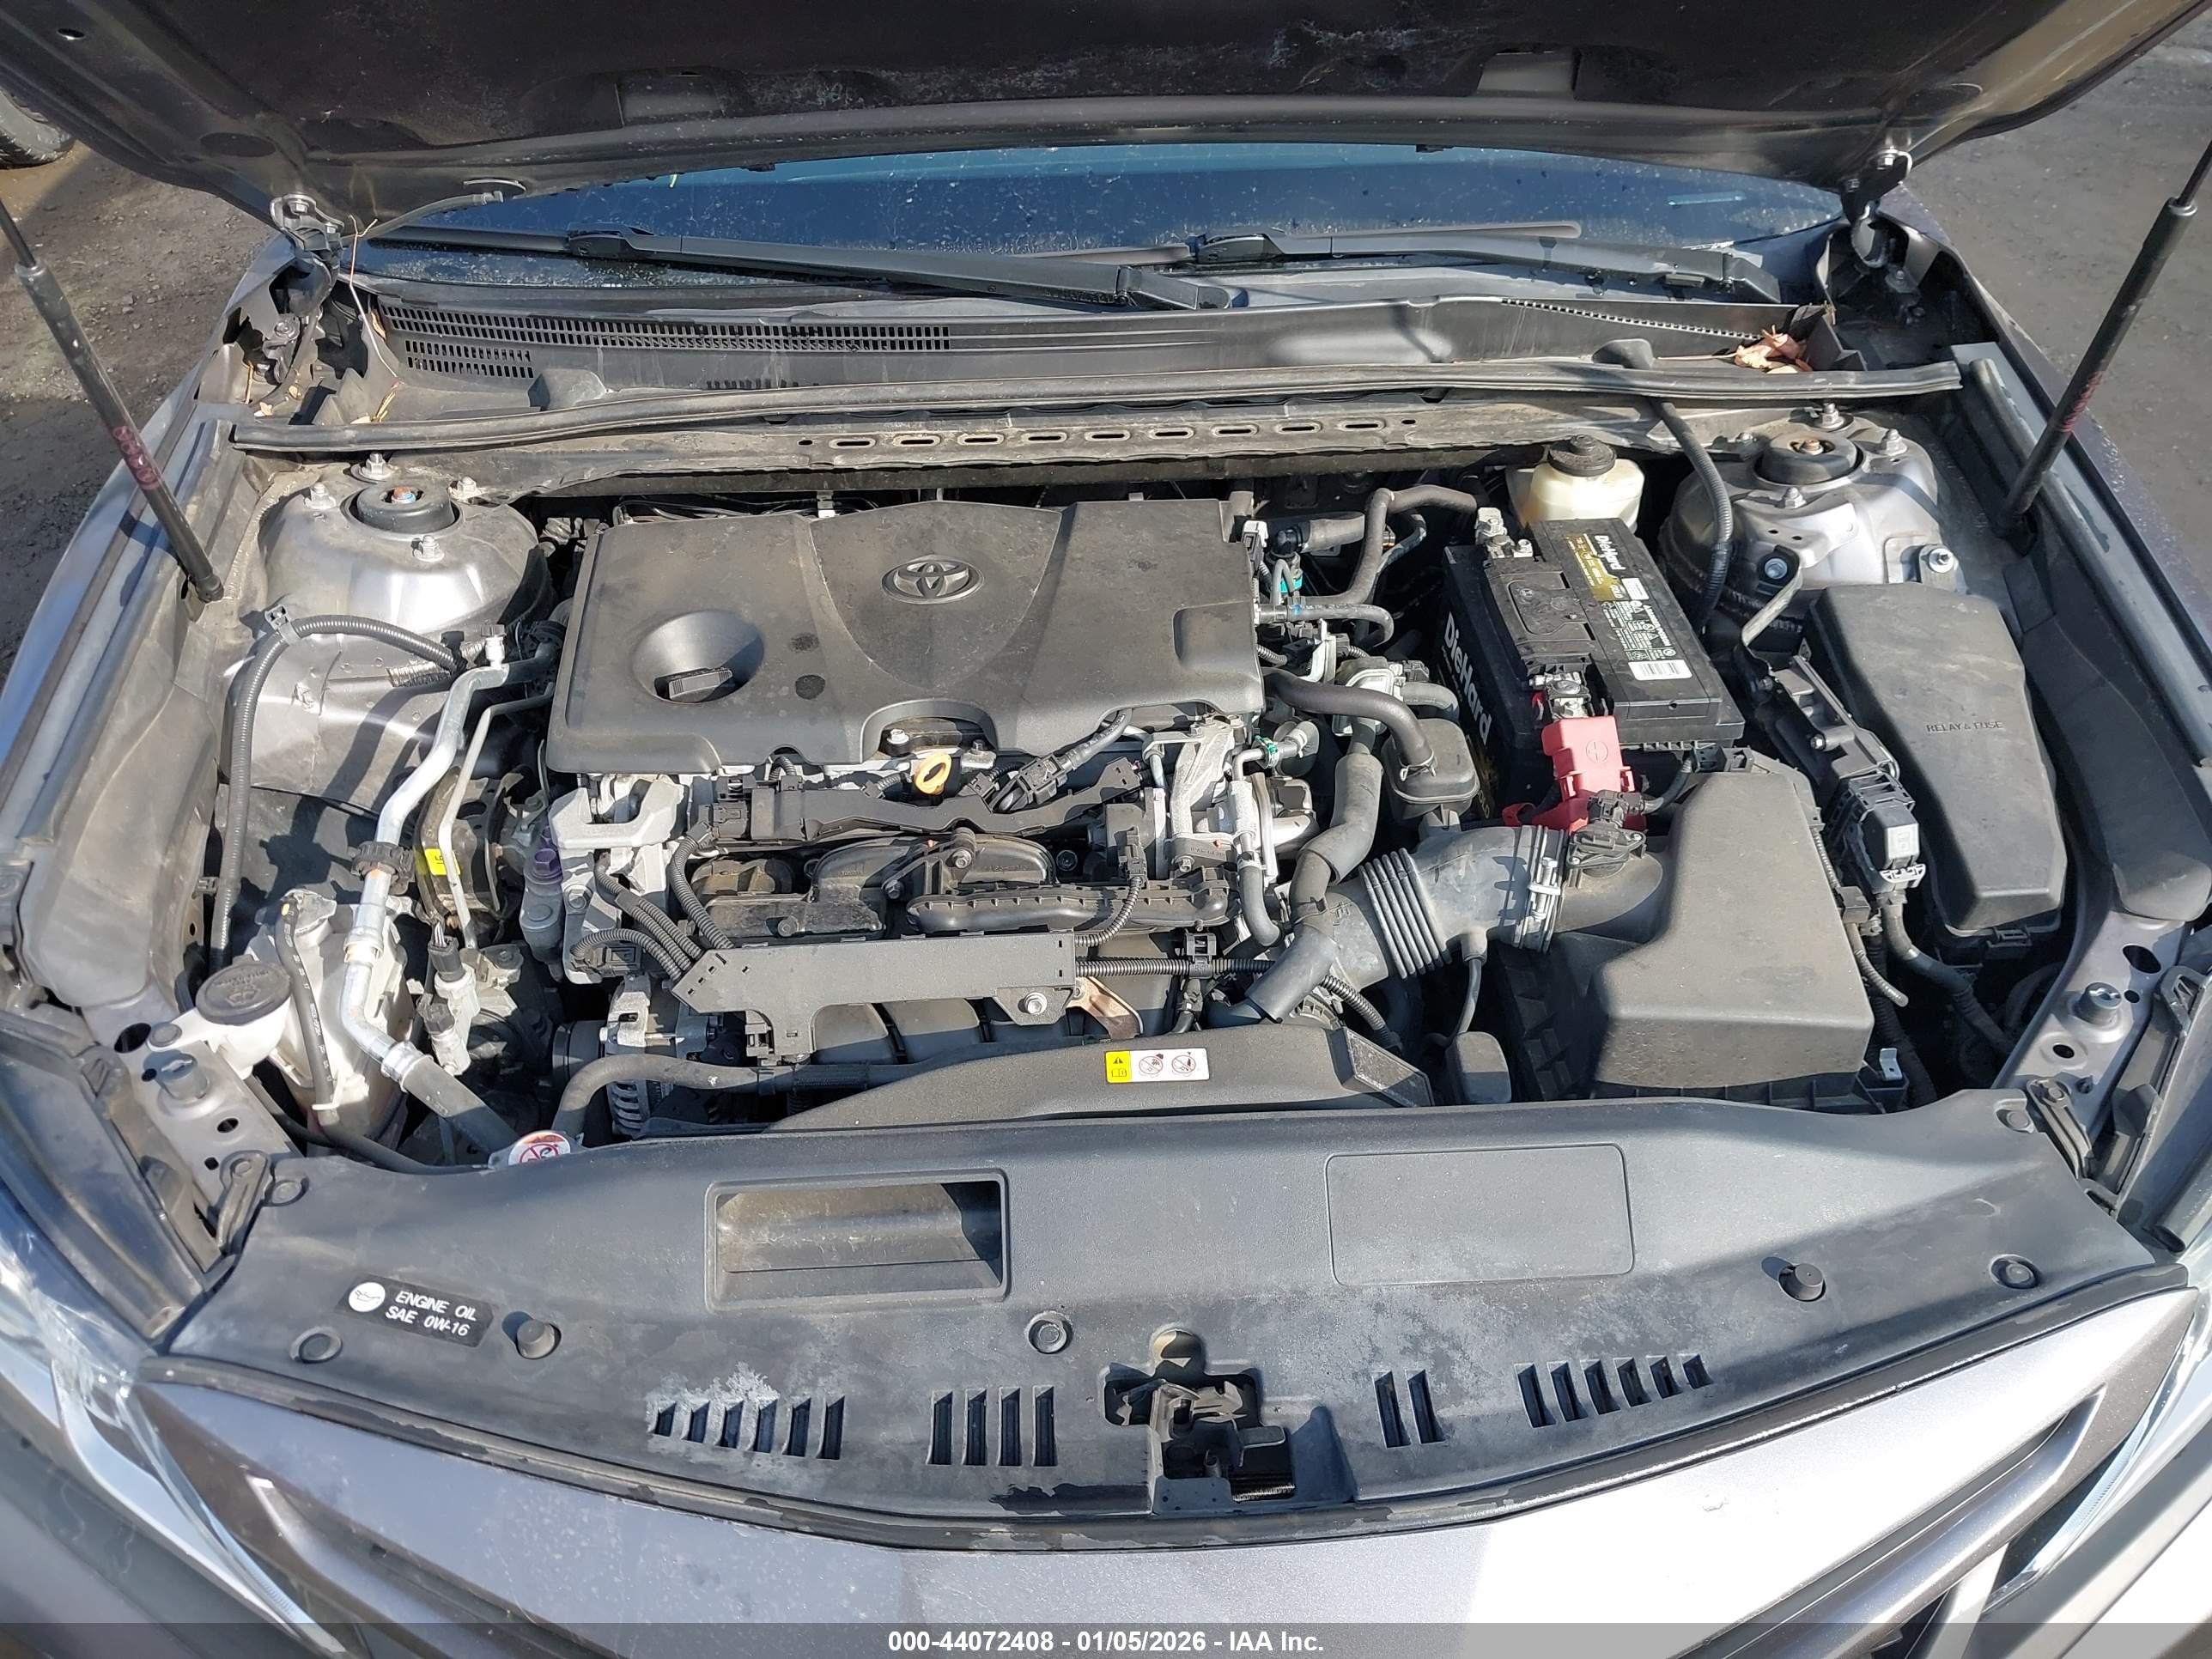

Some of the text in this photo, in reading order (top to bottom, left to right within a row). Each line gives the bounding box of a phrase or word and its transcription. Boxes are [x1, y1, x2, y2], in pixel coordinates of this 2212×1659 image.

[1594, 535, 1626, 570] DieHard
[1444, 611, 1492, 745] DieHard
[1926, 723, 1962, 732] RELAY
[1974, 720, 2004, 729] FUSE
[385, 1305, 471, 1336] SAE 0W-16
[395, 1291, 477, 1322] ENGINE OIL
